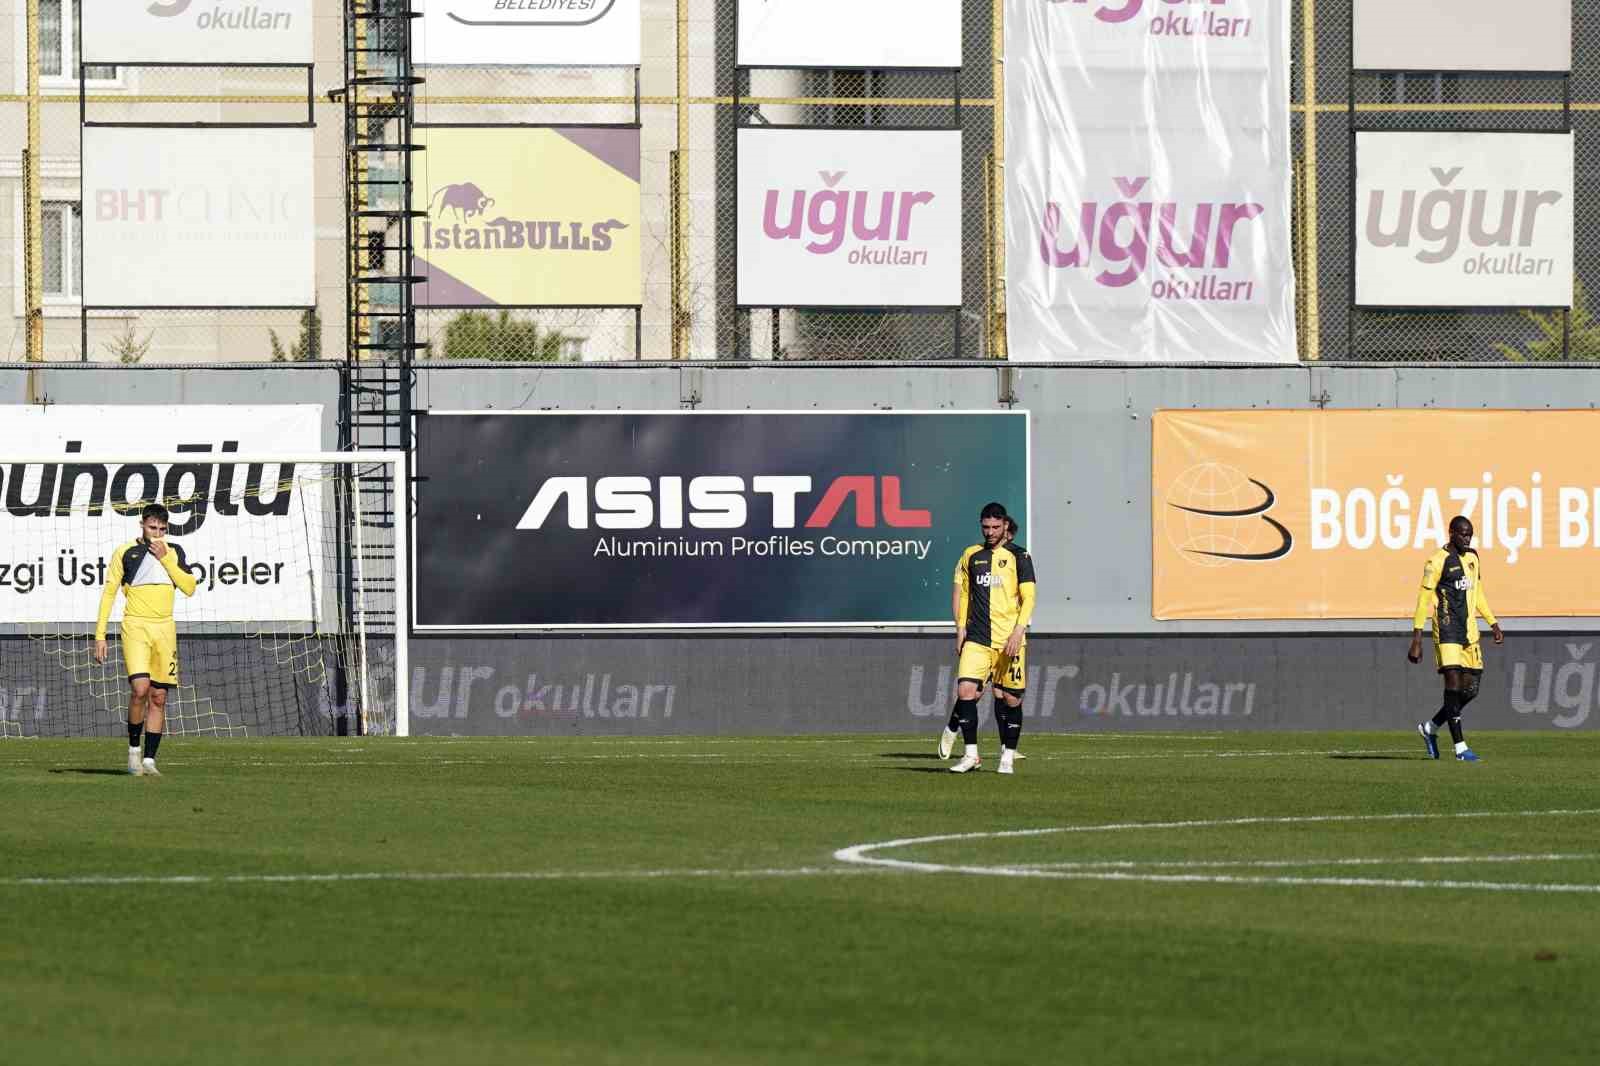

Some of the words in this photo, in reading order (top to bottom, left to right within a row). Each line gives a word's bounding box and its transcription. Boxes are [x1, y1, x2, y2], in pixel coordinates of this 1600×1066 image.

[196, 6, 292, 30] okulları
[95, 189, 170, 221] BHT
[763, 170, 935, 254] uğur
[1366, 166, 1563, 264] uğur
[1040, 176, 1264, 287] uğur
[848, 246, 928, 265] okulları
[1463, 253, 1553, 275] okulları
[1151, 275, 1253, 301] okulları
[515, 475, 932, 529] ASISTAL
[593, 537, 724, 557] Aluminium
[731, 536, 814, 556] Profiles
[820, 536, 931, 560] Company
[189, 555, 285, 592] ojeler
[1009, 666, 1022, 682] 14
[1511, 643, 1600, 729] uğ
[496, 673, 676, 719] okulları
[1080, 672, 1256, 716] okulları
